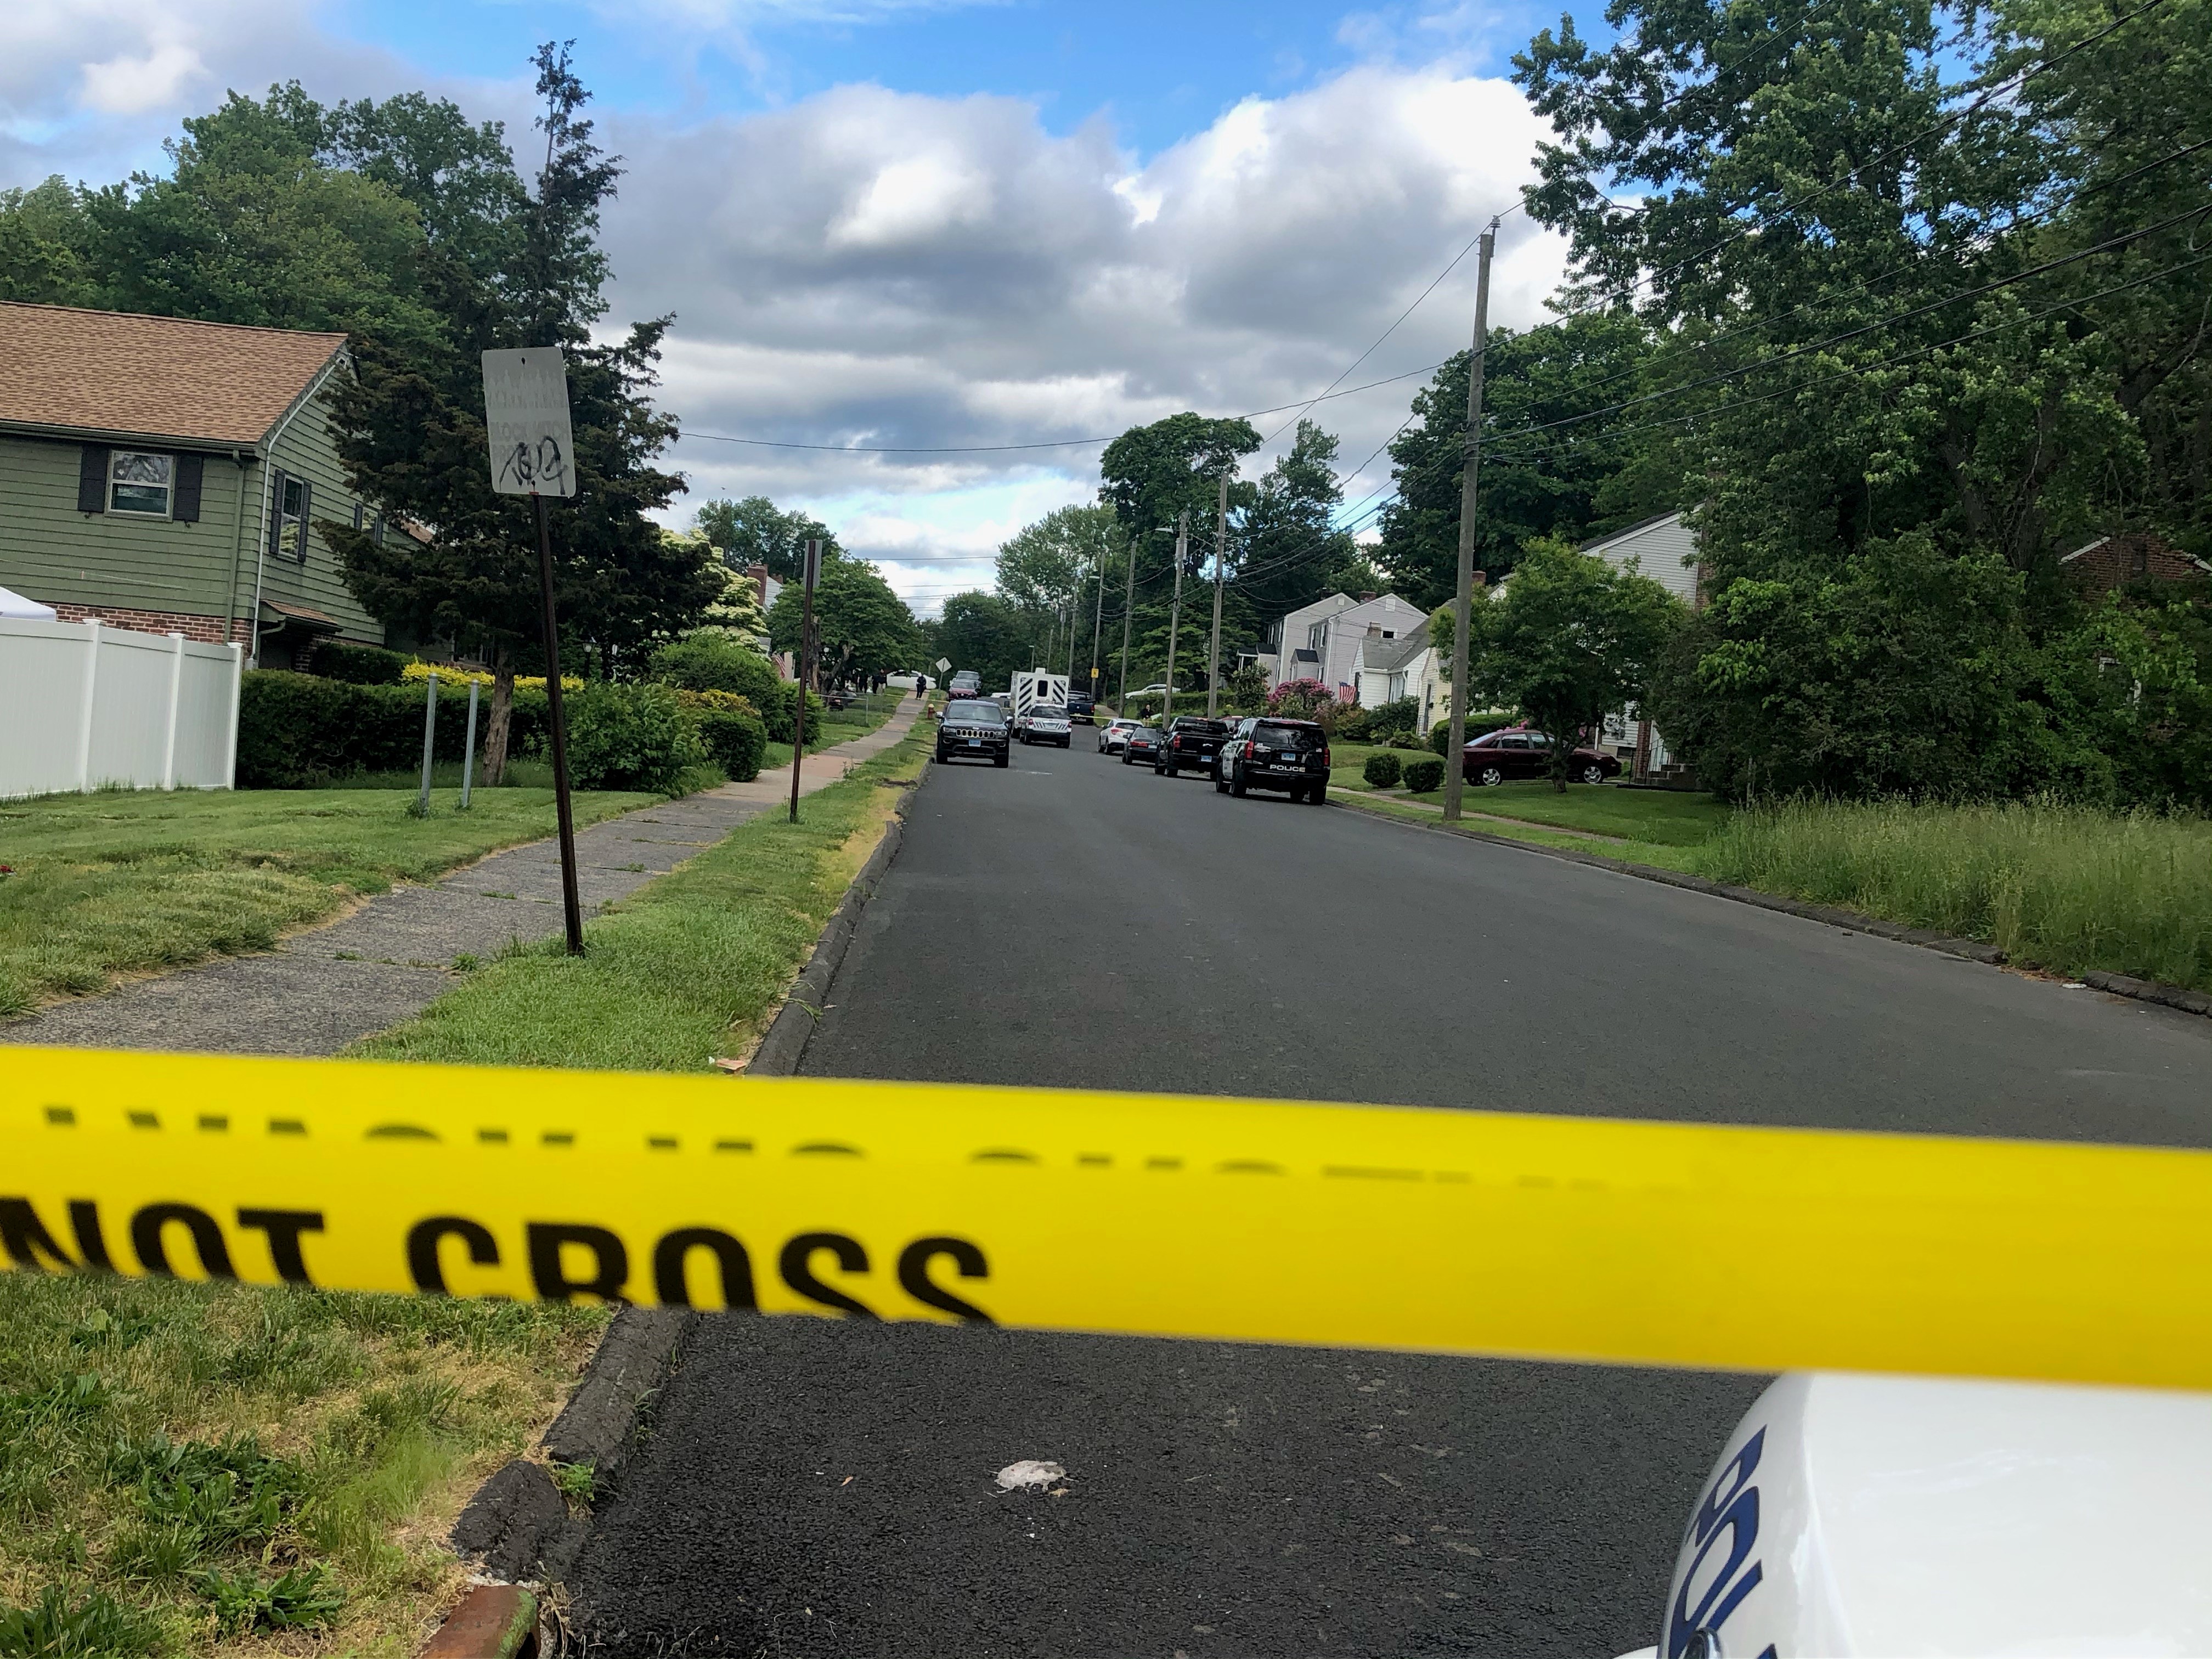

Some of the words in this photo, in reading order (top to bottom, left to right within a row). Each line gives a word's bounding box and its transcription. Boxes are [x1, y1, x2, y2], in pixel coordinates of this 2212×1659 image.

[1269, 764, 1306, 772] POLICE
[0, 1197, 324, 1285] NOT
[406, 1216, 1000, 1325] CROSS
